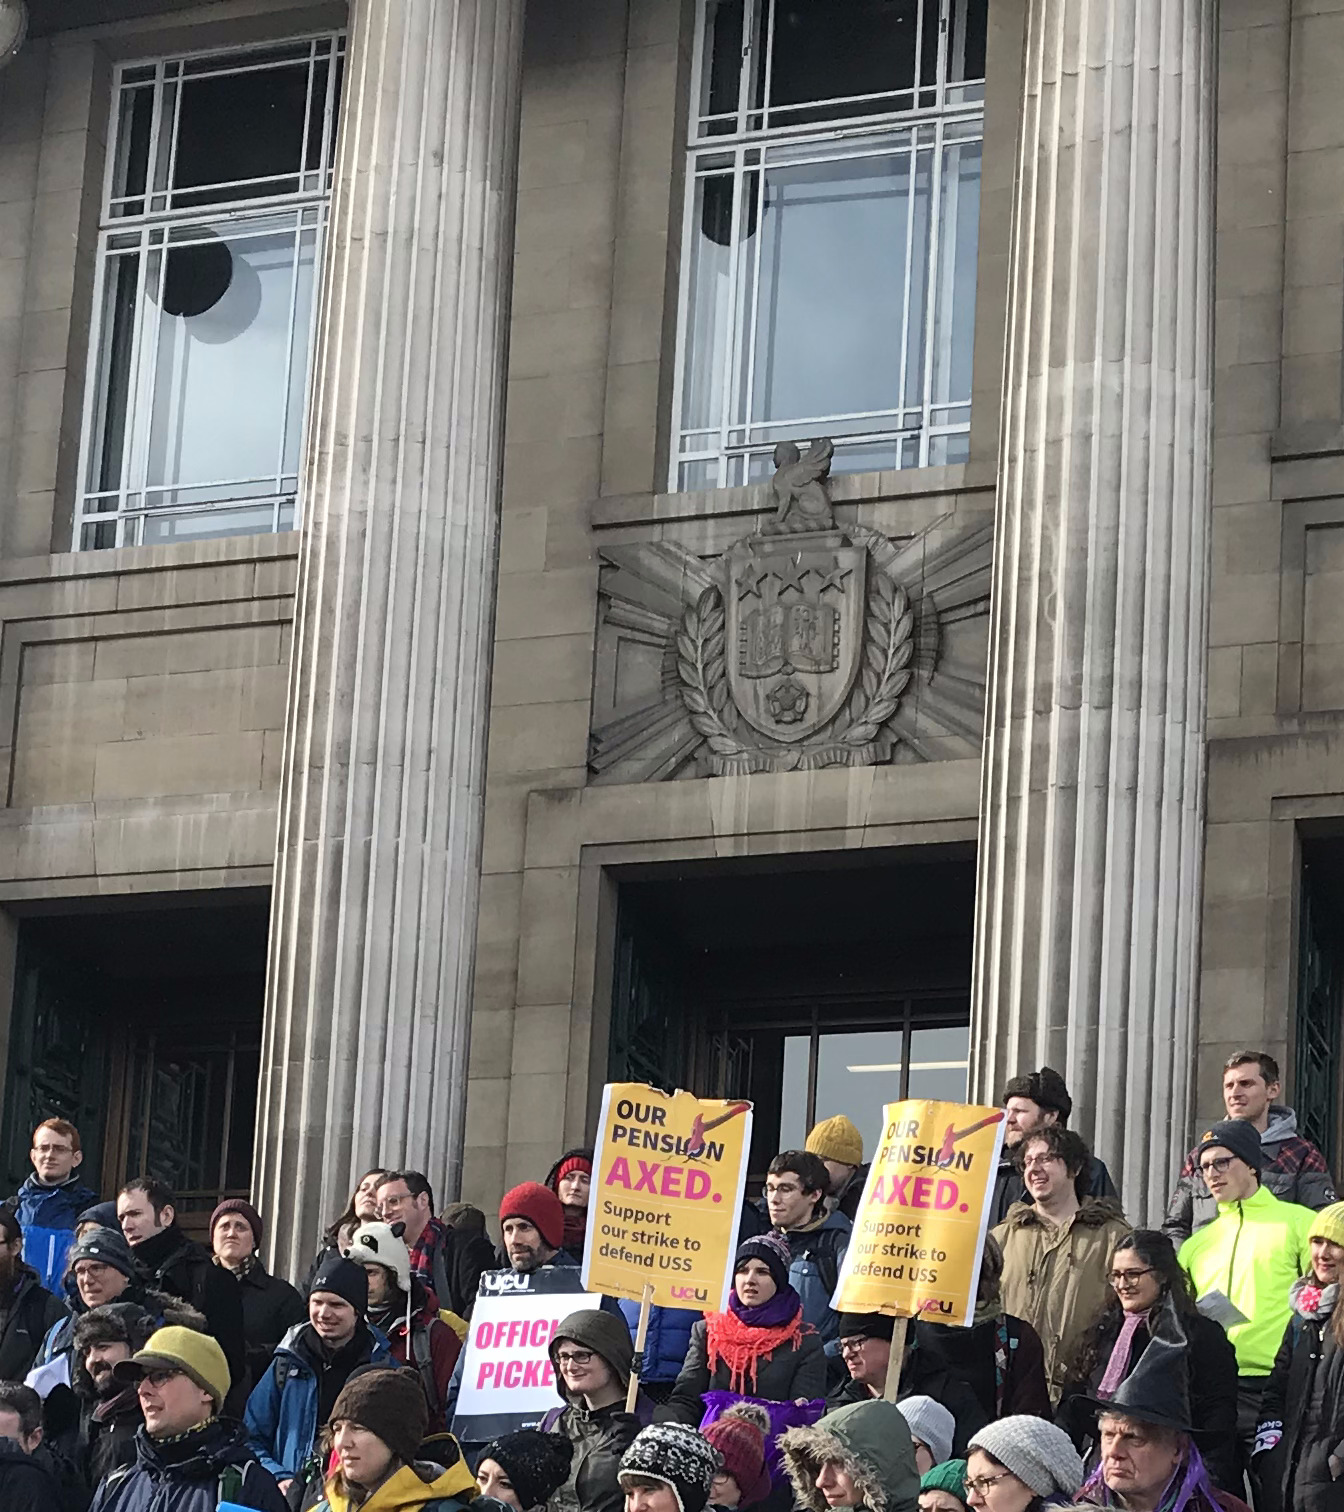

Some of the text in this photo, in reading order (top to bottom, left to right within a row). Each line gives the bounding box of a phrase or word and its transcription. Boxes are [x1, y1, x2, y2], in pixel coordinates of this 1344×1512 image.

[616, 1099, 667, 1127] OUR
[611, 1124, 725, 1162] PENSION
[887, 1119, 920, 1141] OUR
[878, 1144, 975, 1172] PENSION
[605, 1156, 723, 1203] AXED.
[867, 1174, 970, 1214] AXED.
[603, 1201, 672, 1226] Support
[601, 1224, 702, 1252] our strike to
[862, 1219, 923, 1239] Support
[599, 1243, 694, 1273] defend USS
[857, 1243, 947, 1263] our strike to
[852, 1261, 939, 1284] defend USS
[474, 1319, 560, 1350] OFFICI
[476, 1360, 556, 1390] PICKE
